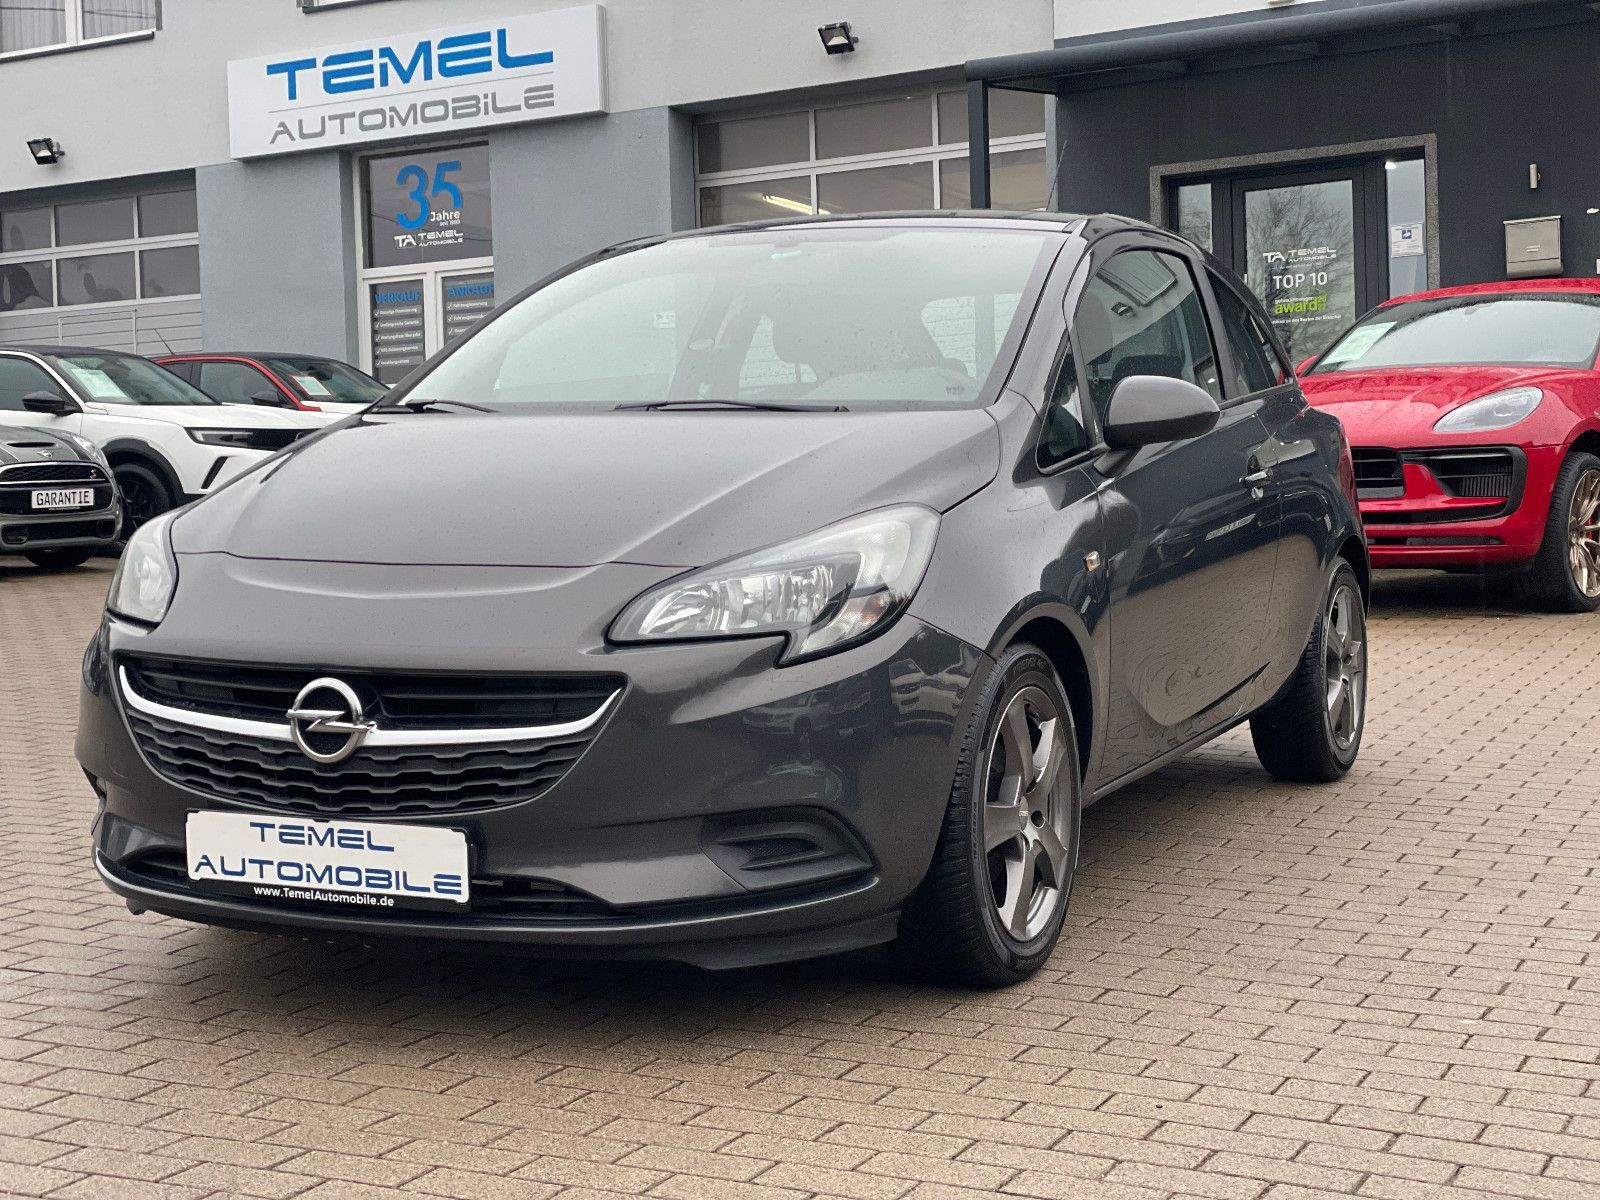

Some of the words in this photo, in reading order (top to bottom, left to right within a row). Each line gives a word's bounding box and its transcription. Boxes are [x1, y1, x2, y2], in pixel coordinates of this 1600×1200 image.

[266, 28, 554, 101] TEMEL
[396, 160, 462, 230] 35
[430, 210, 461, 222] Jahre
[394, 234, 417, 248] TA
[418, 229, 464, 240] TEMEL
[1263, 252, 1286, 263] TA
[1287, 246, 1337, 257] TEMEL
[1273, 273, 1305, 290] TOP
[1310, 271, 1328, 286] 10
[375, 290, 420, 304] VERKAUF
[448, 283, 493, 297] ANKAUF
[1274, 295, 1318, 315] award
[36, 490, 90, 506] GARANTIE
[249, 822, 395, 852] TEMEL
[193, 854, 462, 895] AUTOMOBILE
[253, 886, 395, 907] www.TemelAutomobile.de
